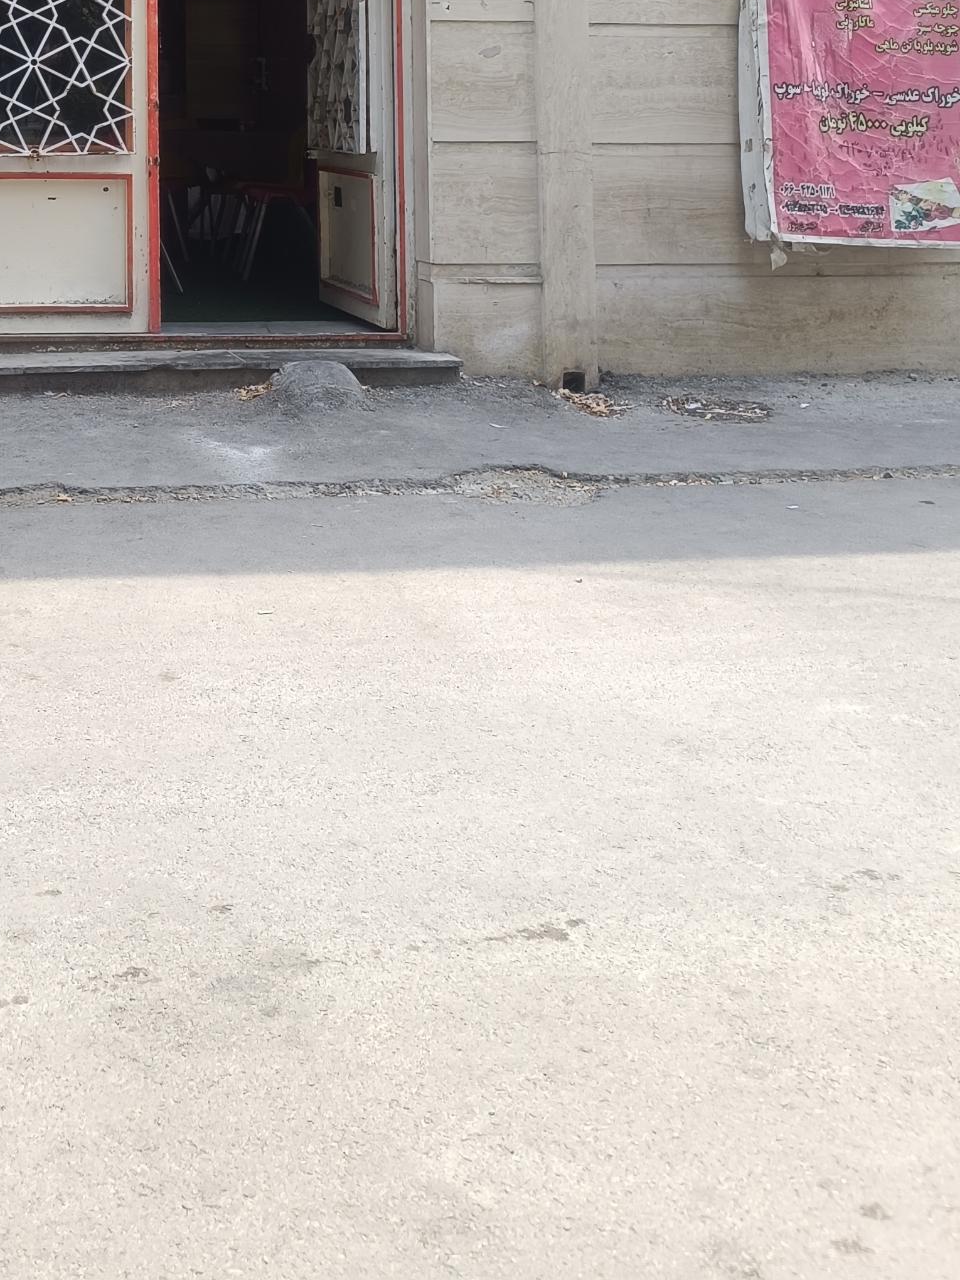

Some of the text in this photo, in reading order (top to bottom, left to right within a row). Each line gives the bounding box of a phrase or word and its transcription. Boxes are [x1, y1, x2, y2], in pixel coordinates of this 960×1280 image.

[913, 2, 959, 18] چلو میکس
[932, 23, 960, 37] جوجه
[875, 38, 900, 52] ماهی
[901, 38, 912, 53] تن
[921, 39, 934, 55] پلو
[935, 40, 959, 56] شوید
[922, 85, 960, 107] خوراک
[819, 111, 848, 134] تومان
[890, 115, 929, 137] کیلویی
